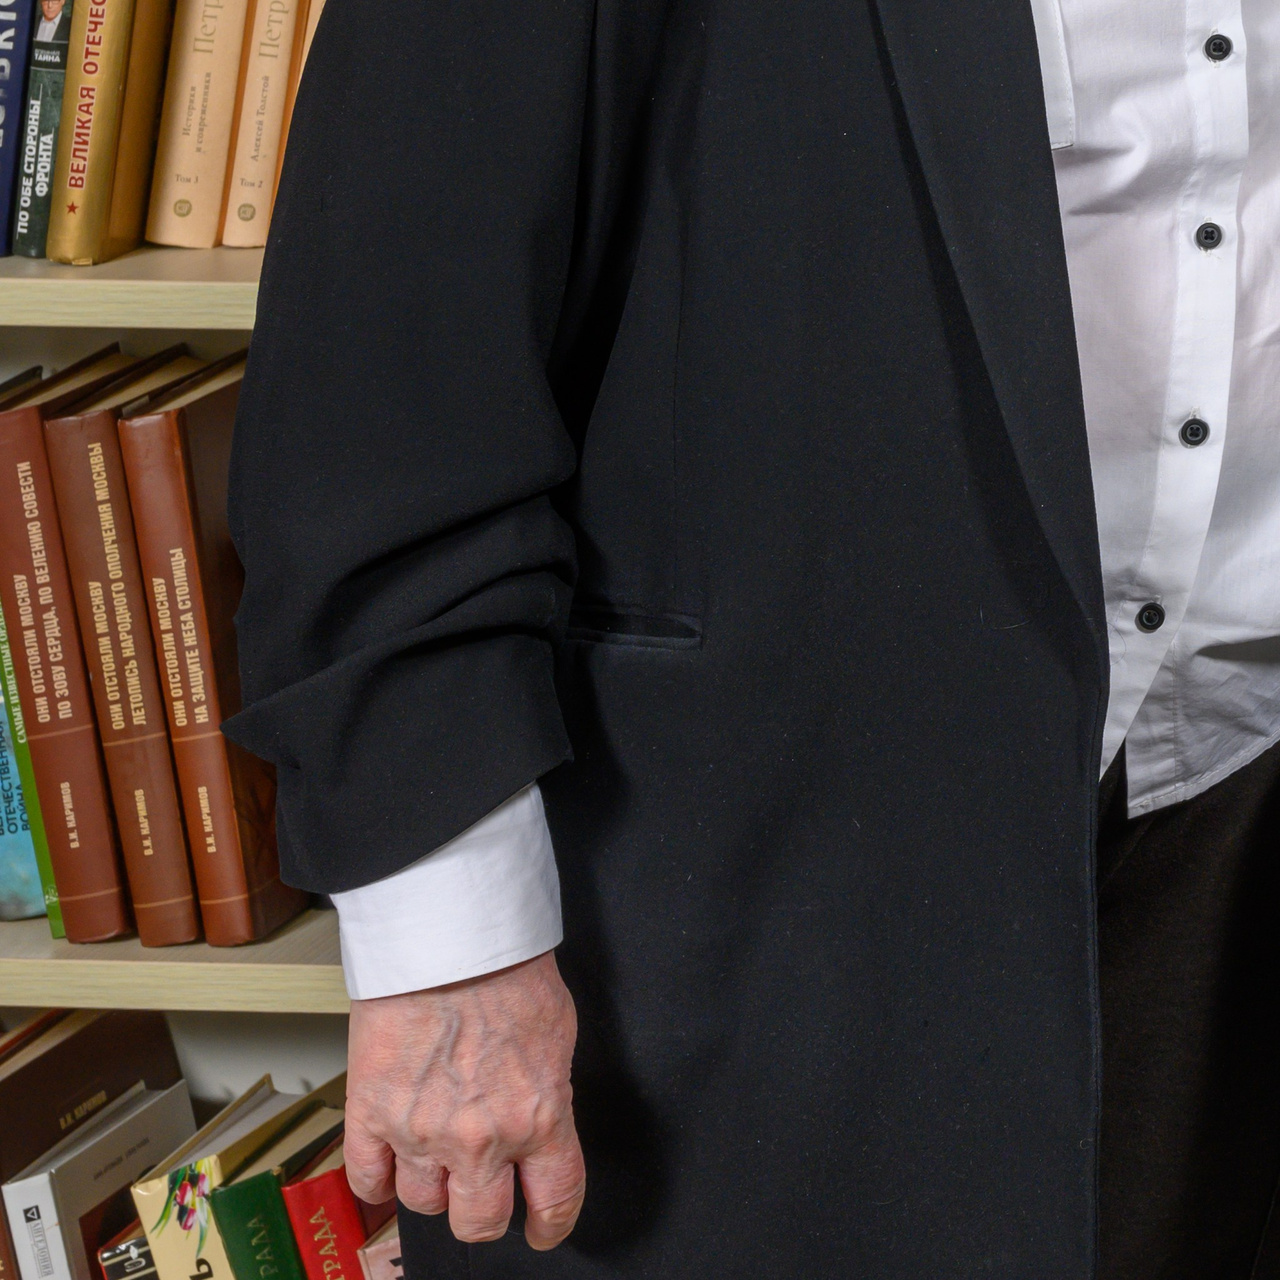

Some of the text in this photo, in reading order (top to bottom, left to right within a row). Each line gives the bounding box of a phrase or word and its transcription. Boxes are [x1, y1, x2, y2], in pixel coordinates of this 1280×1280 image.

[16, 99, 42, 234] ПО ОБЕ СТОРОНЫ
[34, 132, 54, 198] ФРОНТА
[68, 85, 97, 190] ВЕЛИКАЯ
[250, 74, 270, 163] Алексей Толстой
[12, 574, 51, 724] ОНИ ОТСТОЯЛИ МОСКВУ
[87, 442, 147, 726] ЛЕТОПИСЬ НАРОДНОГО ОПОЛЧЕНИЯ МОСКВЫ
[152, 577, 188, 728] ОНИ ОТСТОЯЛИ МОСКВУ
[169, 548, 209, 724] НА ЗАЩИТЕ НЕБА СТОЛИЦЫ
